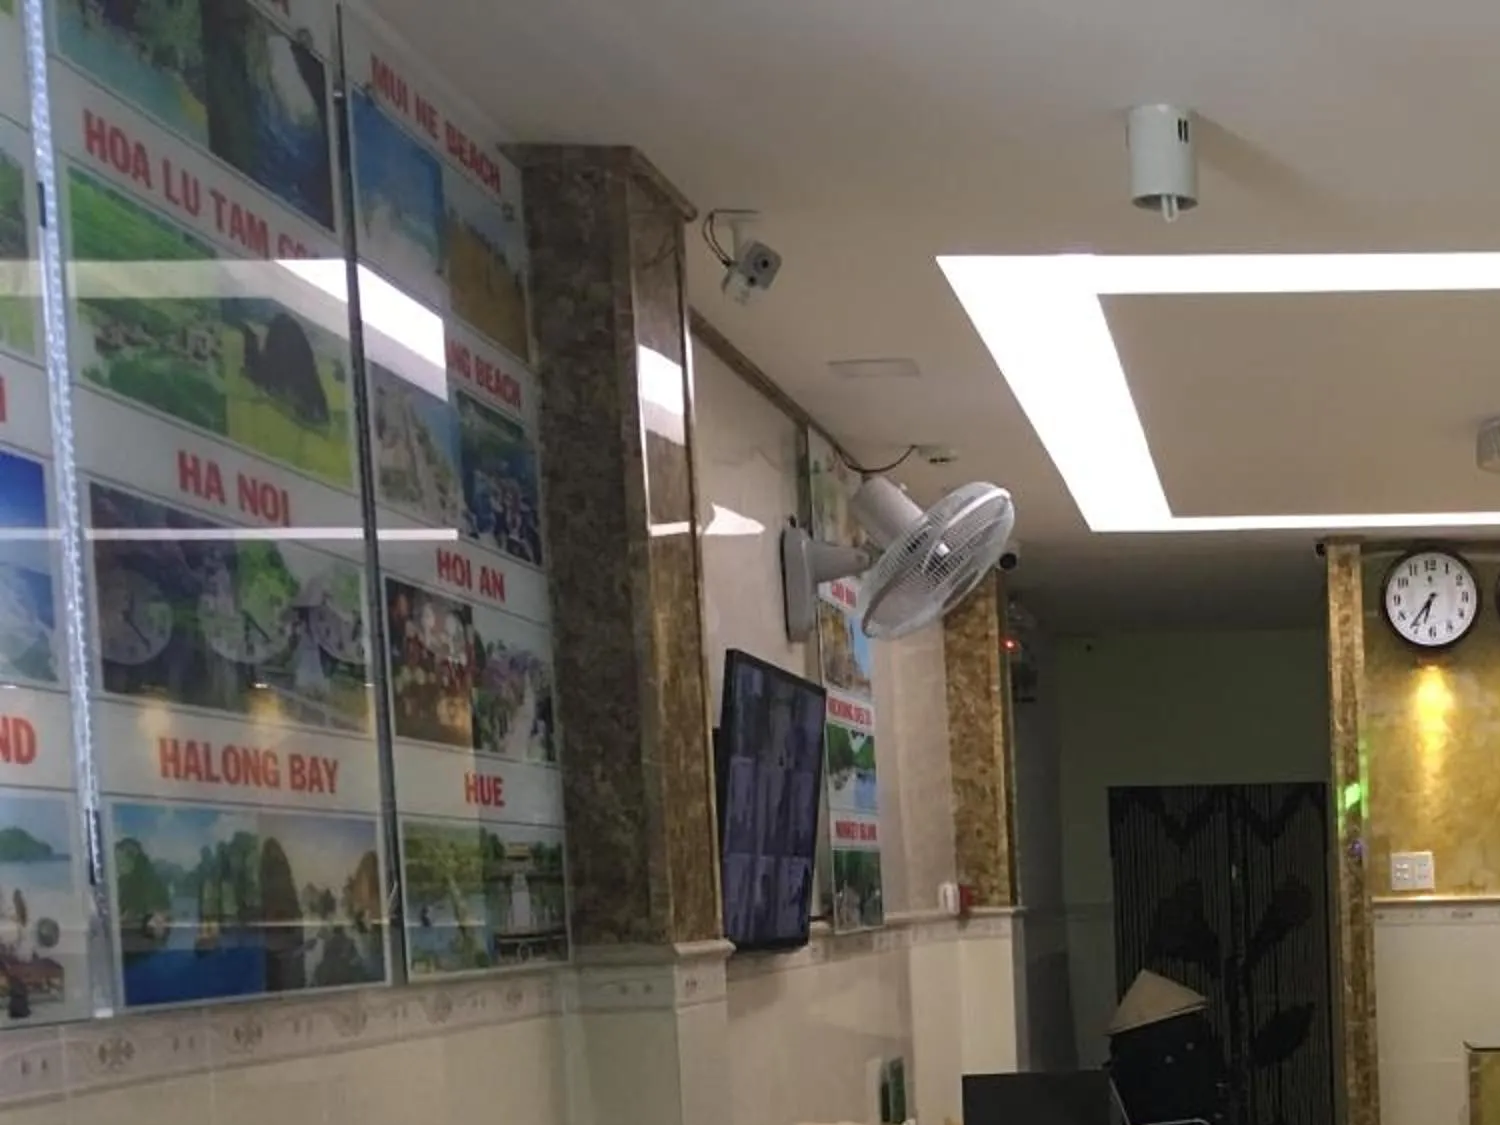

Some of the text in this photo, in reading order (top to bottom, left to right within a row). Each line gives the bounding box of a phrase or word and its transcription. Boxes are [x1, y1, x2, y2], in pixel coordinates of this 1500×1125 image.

[83, 108, 270, 261] HOA LU TAM
[177, 449, 290, 528] HA NOI
[436, 548, 506, 604] HOI AN
[159, 736, 339, 794] HALONG BAY
[463, 771, 506, 808] HUE
